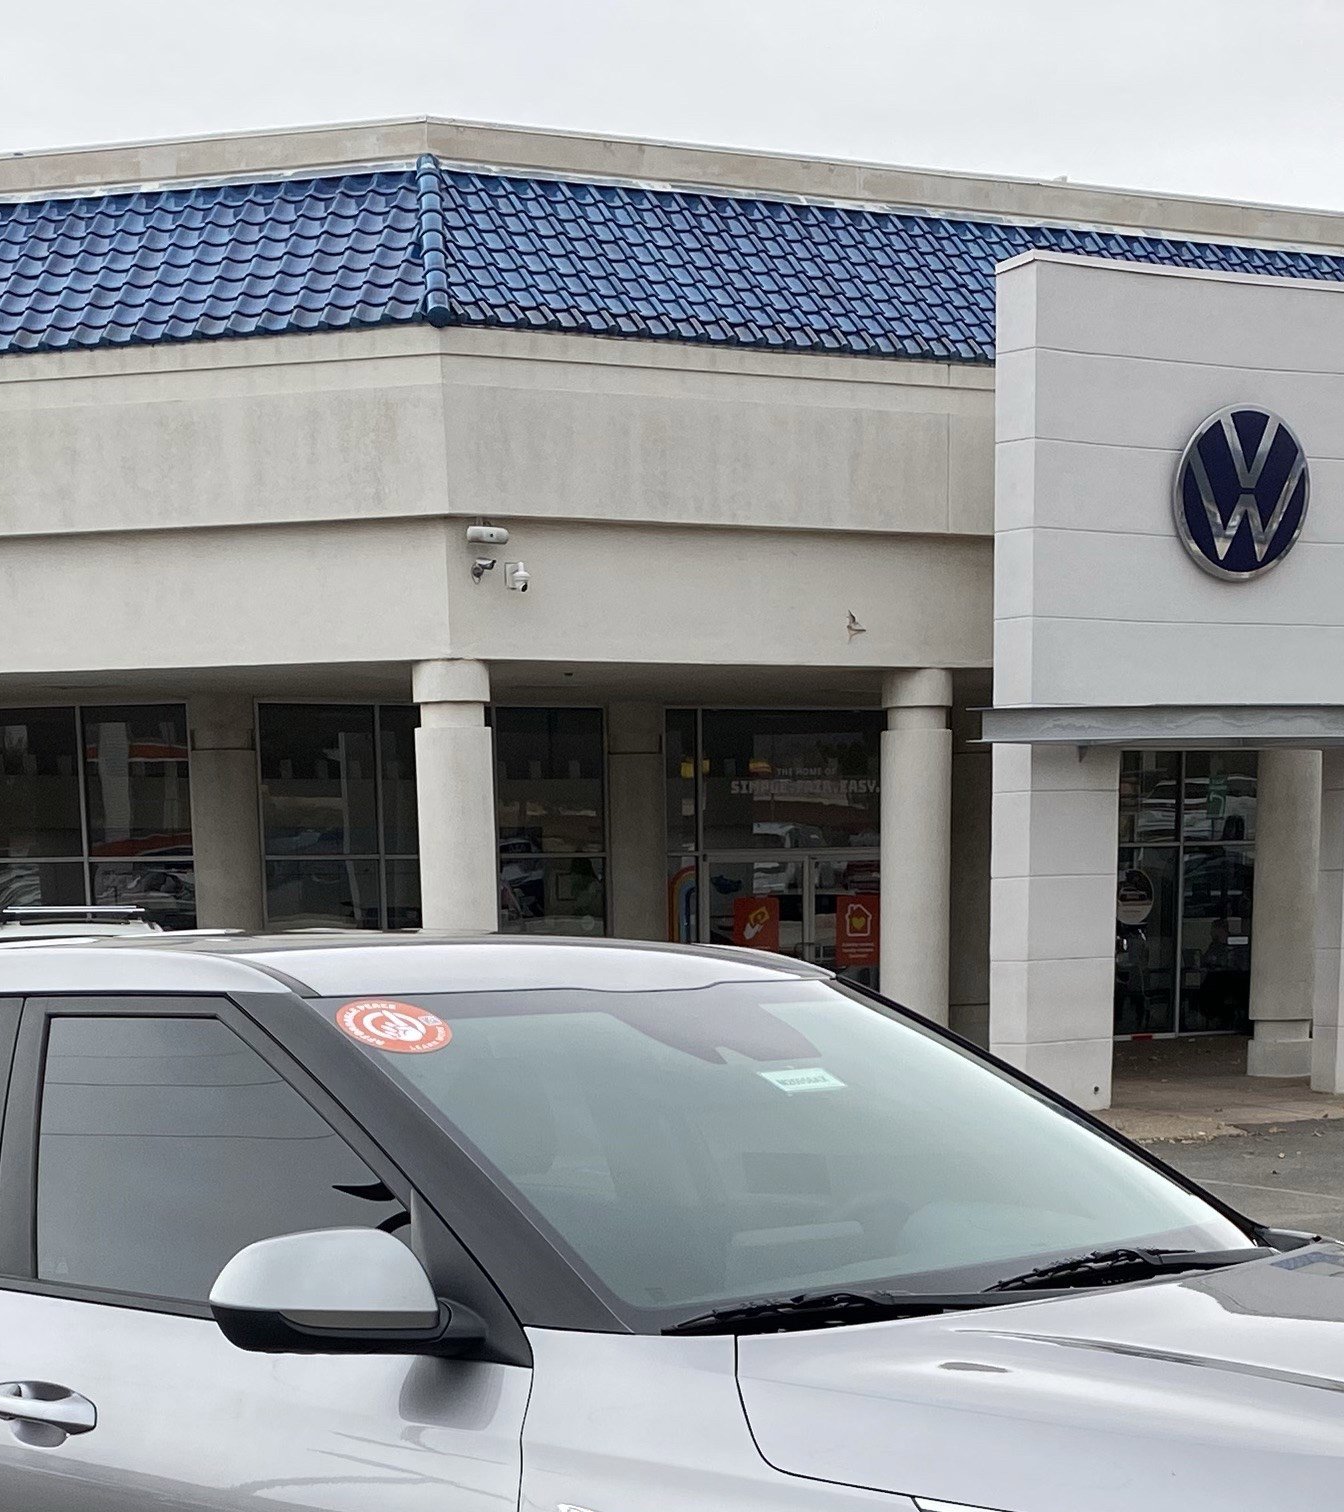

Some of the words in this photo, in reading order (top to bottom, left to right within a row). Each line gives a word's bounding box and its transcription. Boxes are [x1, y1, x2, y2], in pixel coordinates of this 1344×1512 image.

[1180, 405, 1308, 570] VW
[777, 768, 792, 776] THE
[795, 768, 821, 776] HOME
